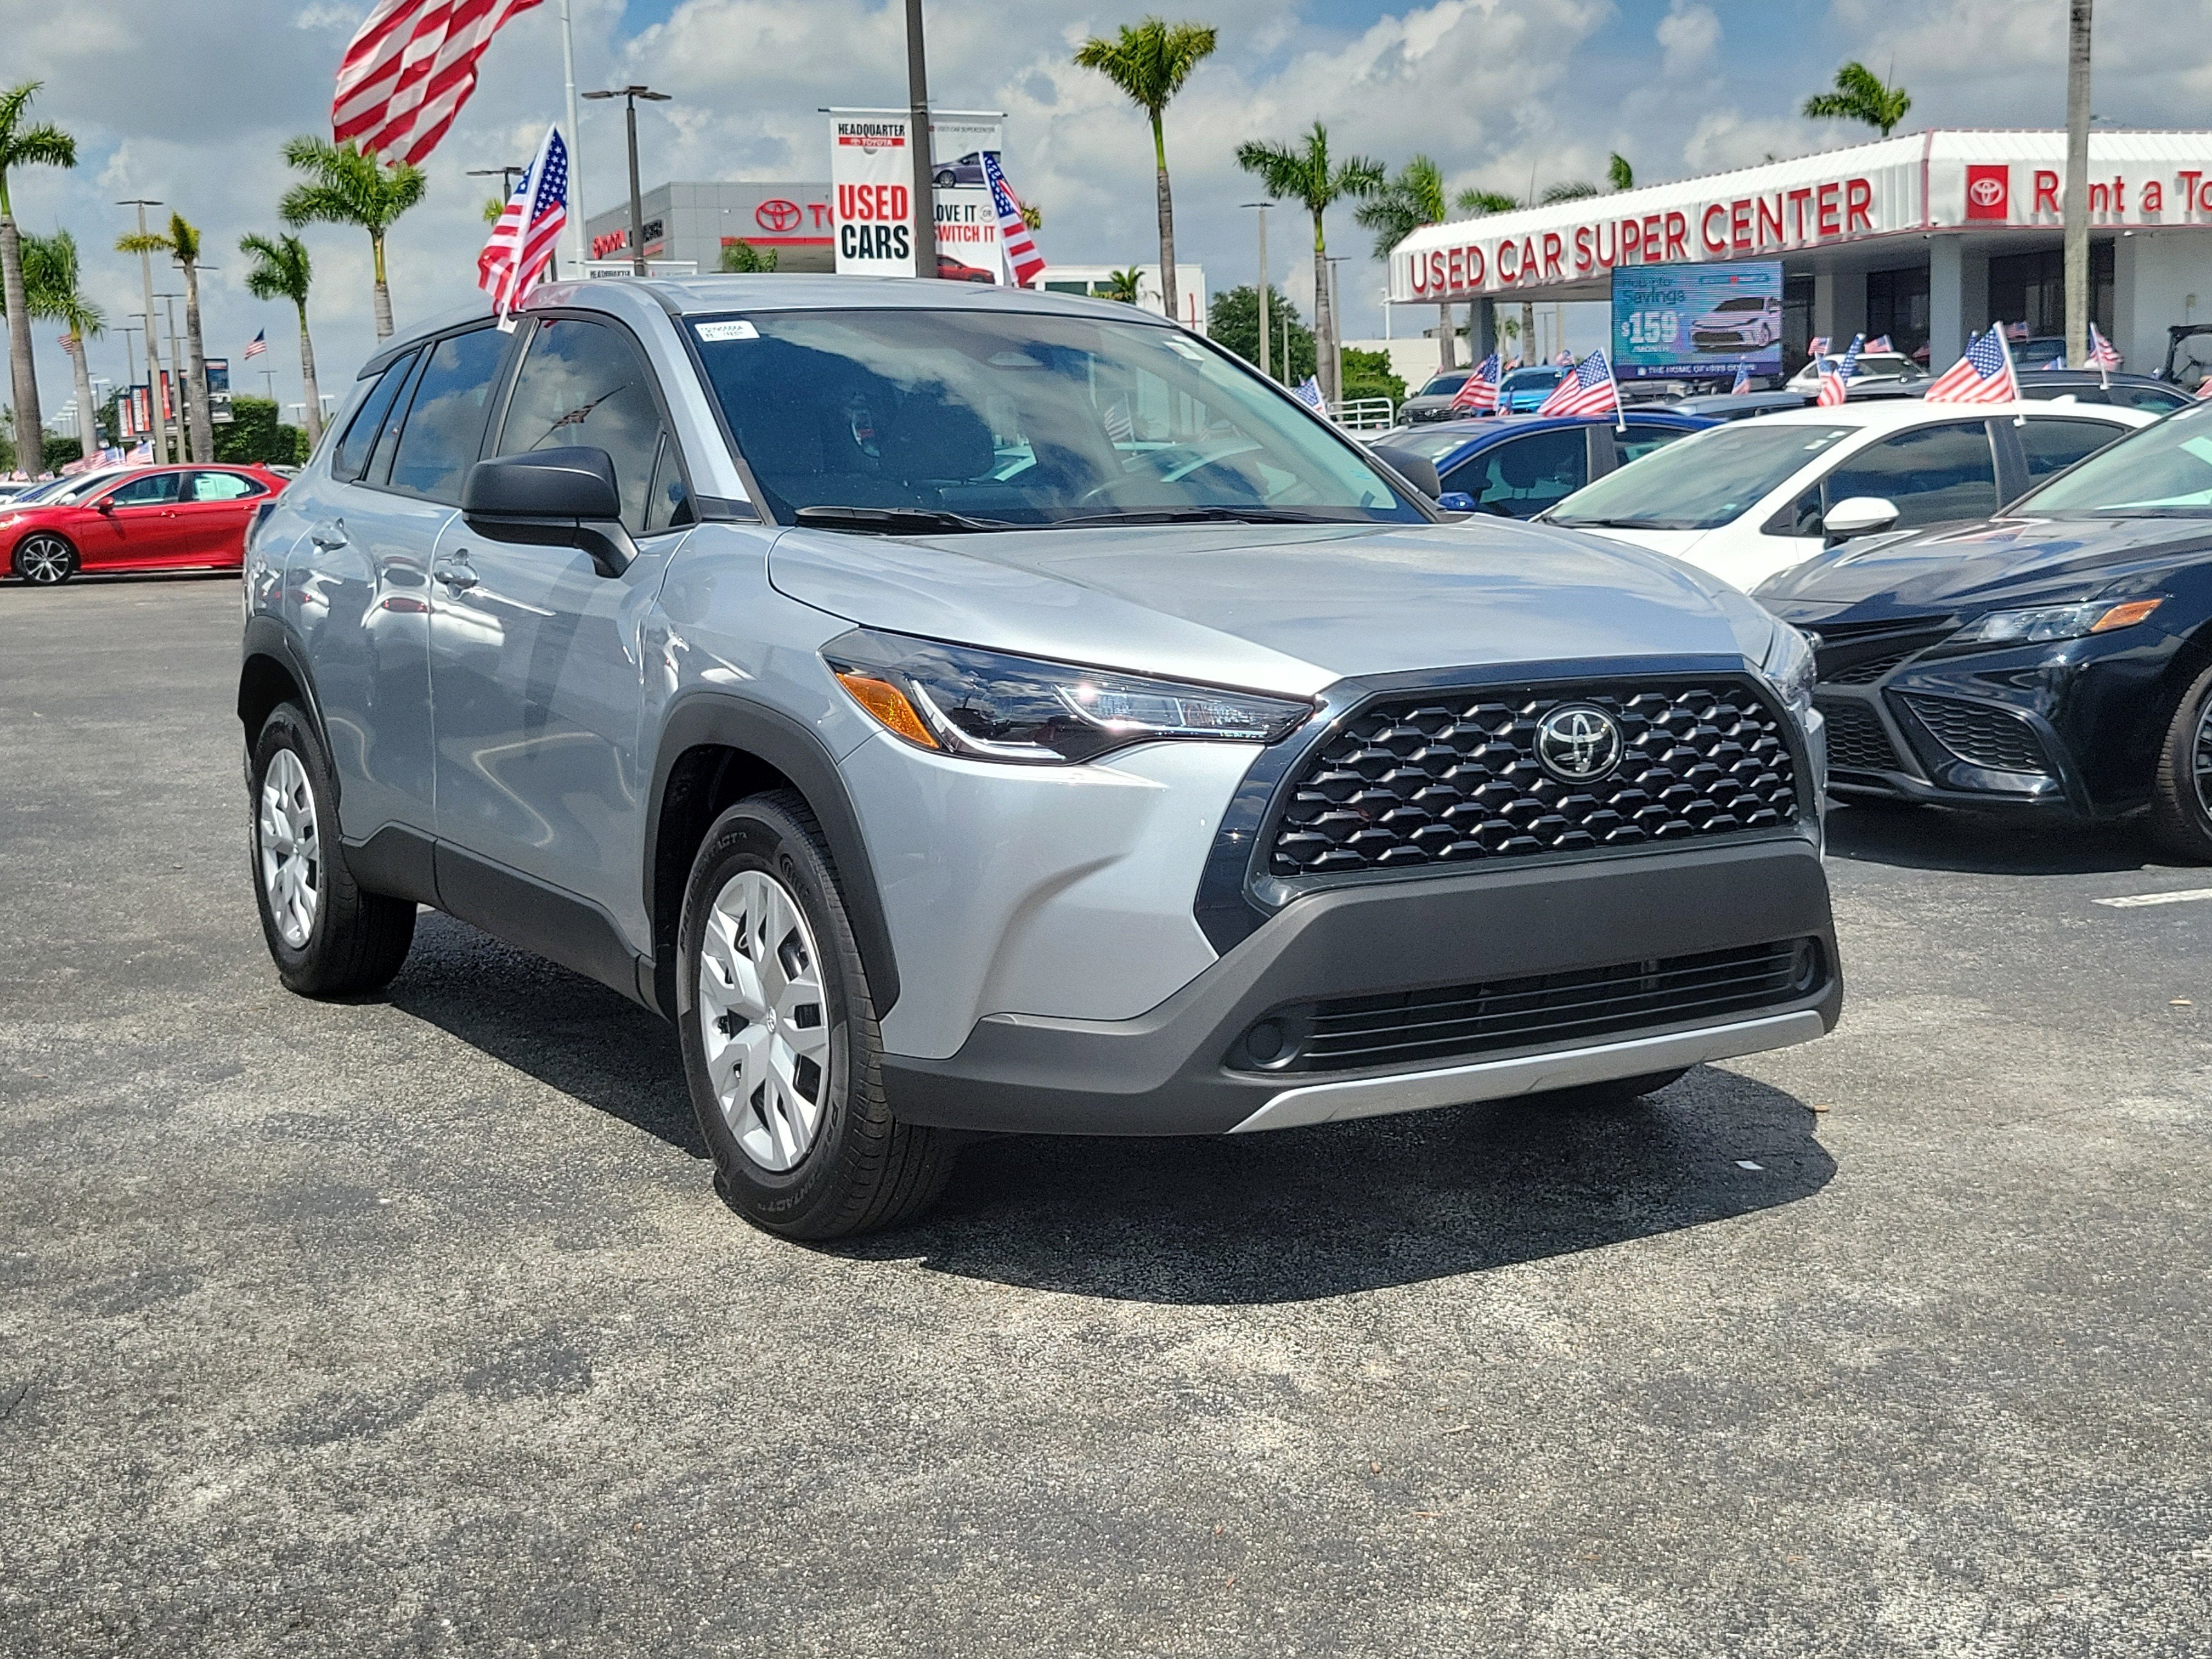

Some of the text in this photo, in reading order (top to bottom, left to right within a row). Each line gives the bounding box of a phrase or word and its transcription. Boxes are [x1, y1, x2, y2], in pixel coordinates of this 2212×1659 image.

[838, 123, 905, 138] HEADQUARTER
[862, 138, 893, 146] TOYOTA
[839, 185, 909, 221] USED
[2034, 170, 2125, 213] Rnt
[2143, 181, 2162, 212] a
[965, 205, 977, 222] IT
[983, 209, 992, 218] OR
[841, 224, 909, 259] CARS
[984, 226, 995, 242] IT
[1410, 177, 1872, 295] USED CAR SUPER CENTER
[1621, 287, 1685, 305] Savings
[1621, 310, 1679, 343] $159
